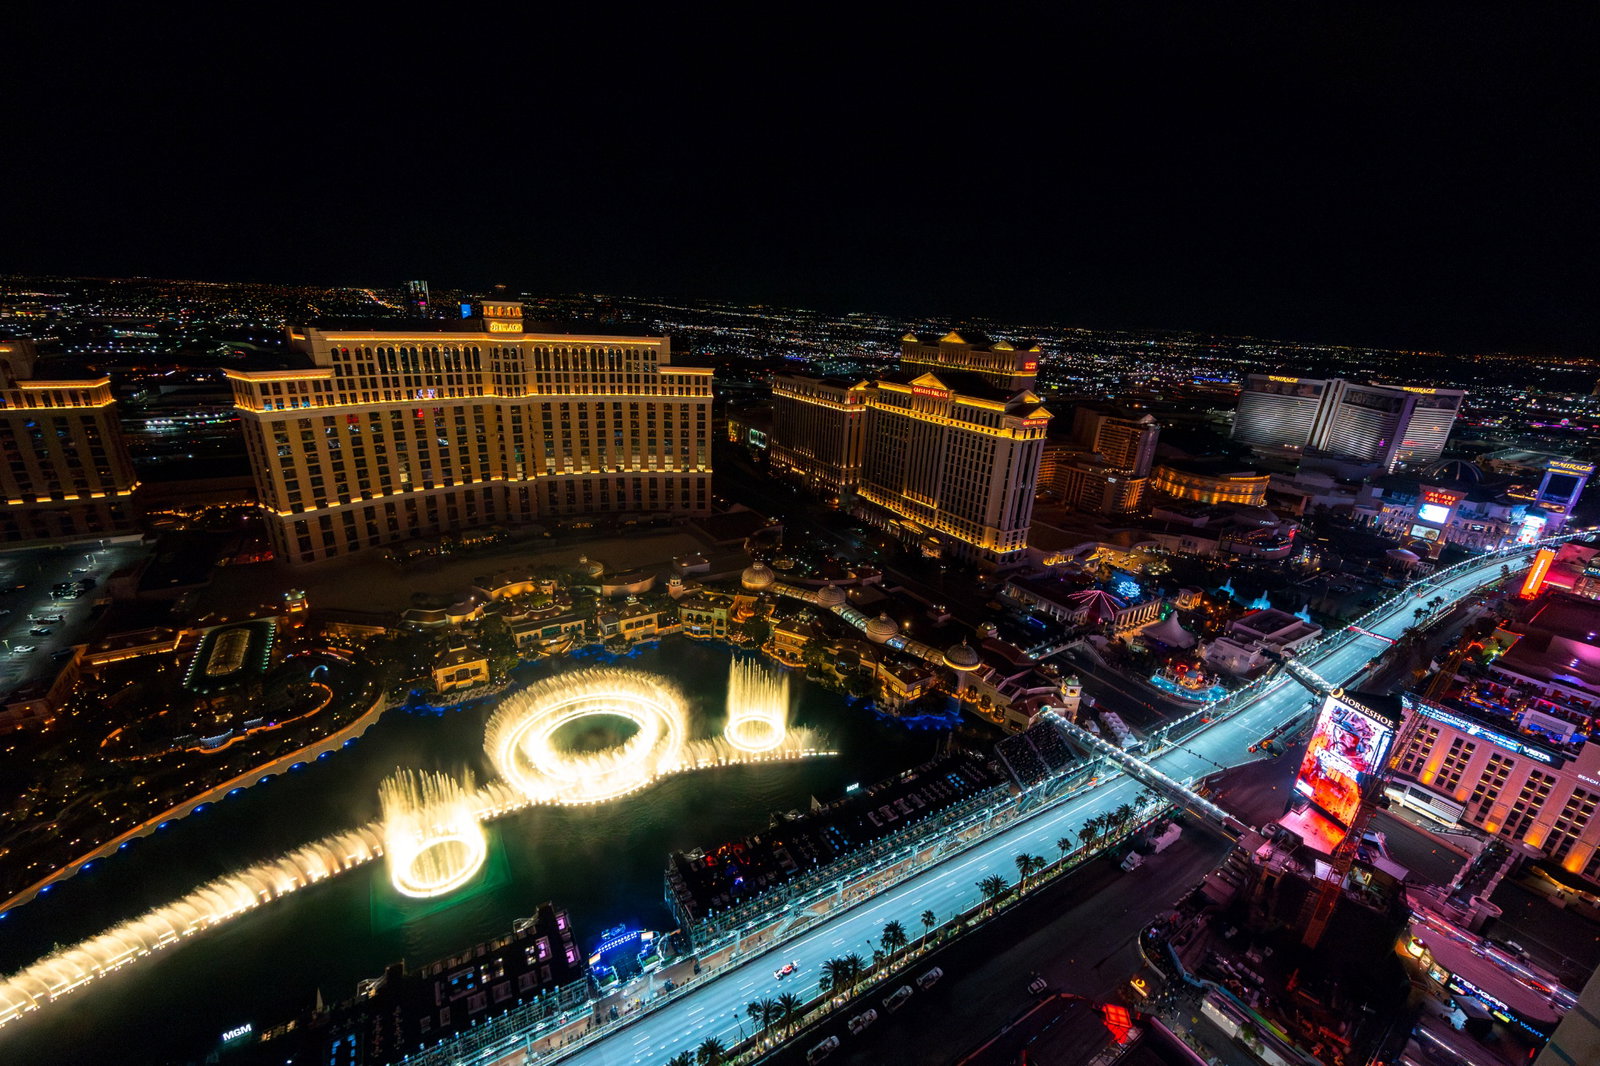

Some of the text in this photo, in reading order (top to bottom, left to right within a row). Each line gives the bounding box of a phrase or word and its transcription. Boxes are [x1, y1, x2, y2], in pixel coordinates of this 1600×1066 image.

[931, 389, 948, 398] PALACE
[1558, 463, 1593, 472] MIRAGE
[1341, 694, 1394, 729] HORSESHOE
[1577, 774, 1599, 785] BEACH
[1501, 1010, 1518, 1022] YOU
[1520, 1021, 1544, 1037] WANT
[222, 1023, 252, 1041] MGM
